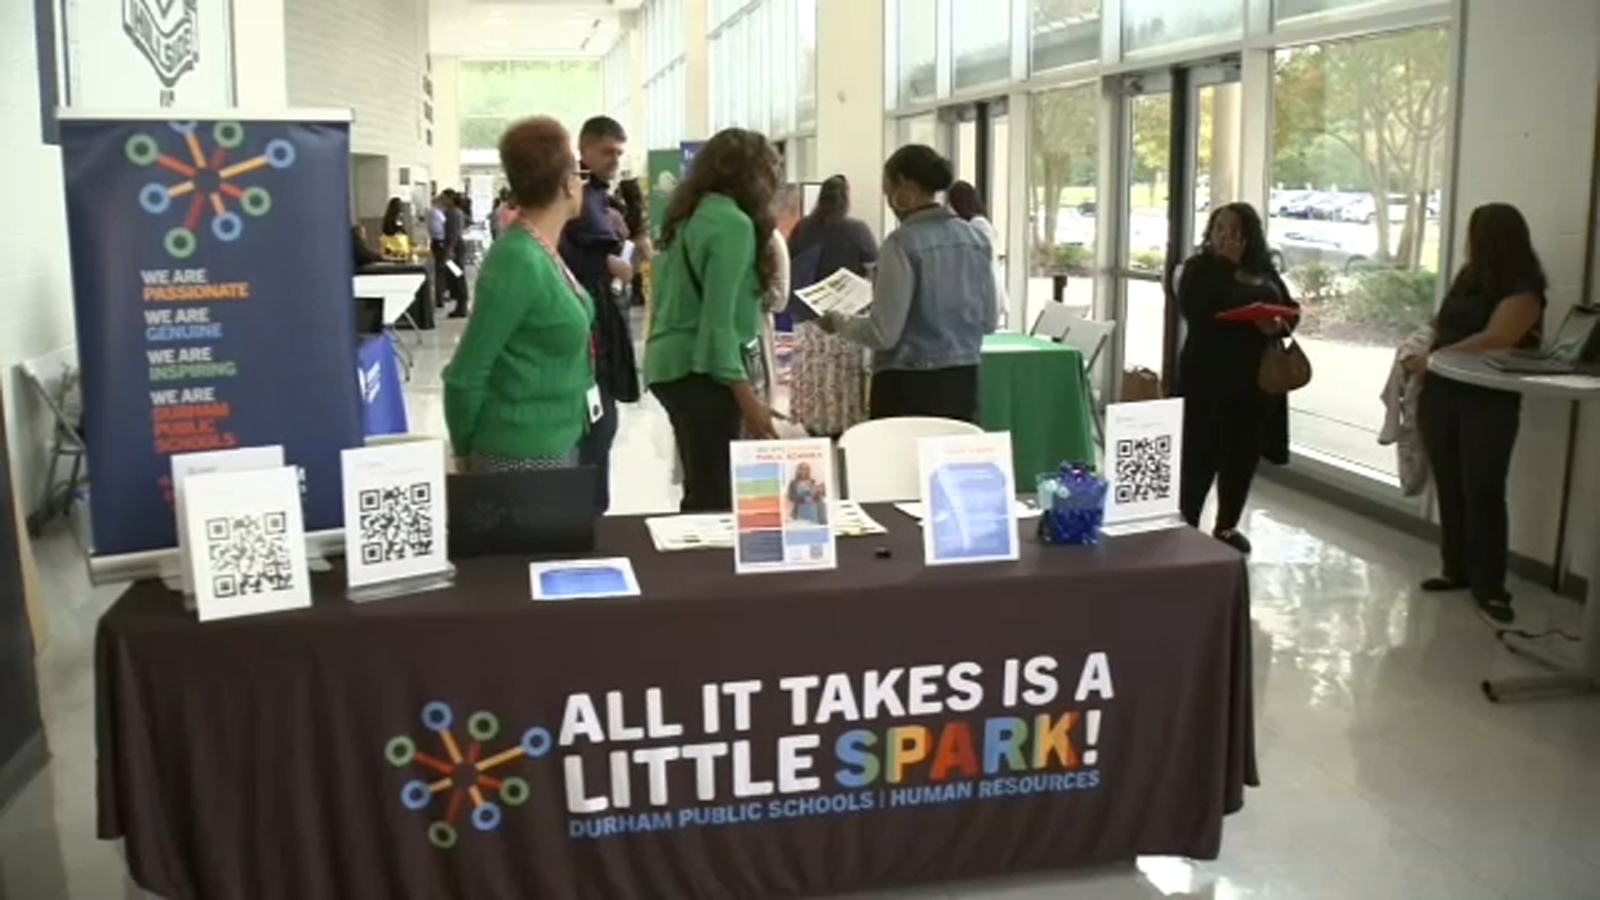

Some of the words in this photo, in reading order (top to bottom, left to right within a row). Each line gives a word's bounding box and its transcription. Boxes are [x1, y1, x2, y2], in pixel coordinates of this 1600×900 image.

[141, 269, 169, 285] WE
[172, 268, 206, 283] ARE
[143, 282, 249, 301] PASSIONATE
[144, 309, 172, 324] WE
[175, 307, 210, 322] ARE
[146, 322, 222, 341] GENUINE
[146, 349, 175, 364] WE
[178, 346, 212, 362] ARE
[149, 361, 237, 380] INSPIRING
[150, 389, 178, 405] WE
[181, 387, 215, 403] ARE
[154, 418, 215, 438] PUBLIC
[156, 432, 234, 453] SCHOOLS
[559, 693, 683, 746] ALL
[702, 679, 762, 734] IT
[779, 661, 984, 726] TAKES
[1002, 655, 1059, 707] IS
[1074, 652, 1114, 701] A
[564, 734, 821, 814] LITTLE
[834, 709, 1101, 787] SPARK!
[569, 812, 673, 838] DURHAM
[678, 802, 763, 828] PUBLIC
[768, 791, 874, 818] SCHOOLS
[890, 781, 973, 807] HUMAN
[978, 769, 1100, 798] RESOURCES
